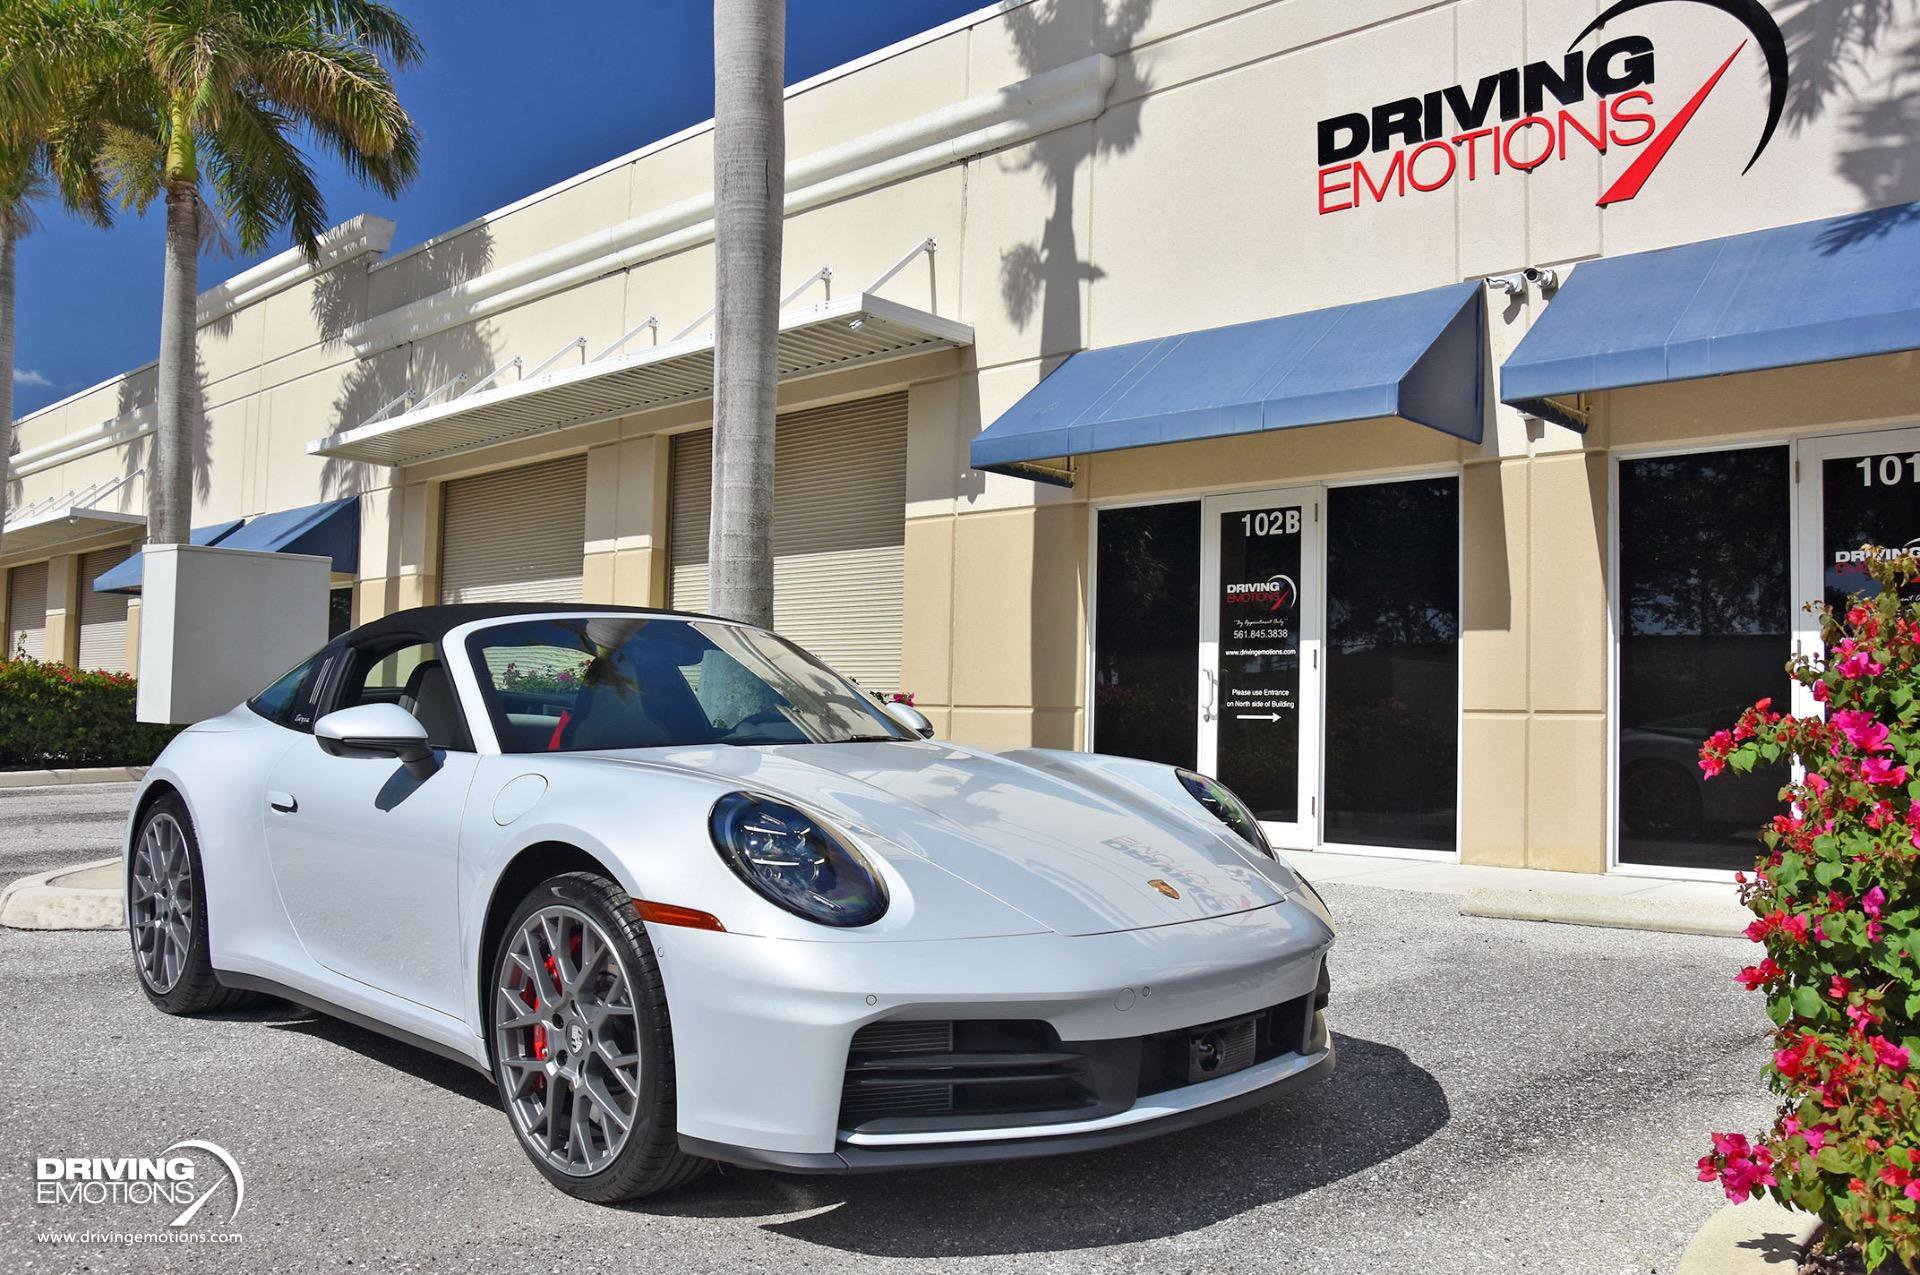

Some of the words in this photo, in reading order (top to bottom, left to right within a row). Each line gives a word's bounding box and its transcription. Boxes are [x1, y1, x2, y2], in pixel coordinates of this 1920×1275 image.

[1317, 35, 1655, 167] DRIVING
[1318, 90, 1656, 215] EMOTIONS
[1856, 453, 1920, 487] 101
[1241, 510, 1301, 537] 102B
[1226, 582, 1280, 593] DRIVING
[1226, 592, 1279, 603] EMOTIONS
[1233, 629, 1289, 639] 561.845.3838
[1224, 649, 1297, 657] www.drivingemotions.com
[1231, 688, 1251, 696] Please
[1271, 700, 1295, 709] Building
